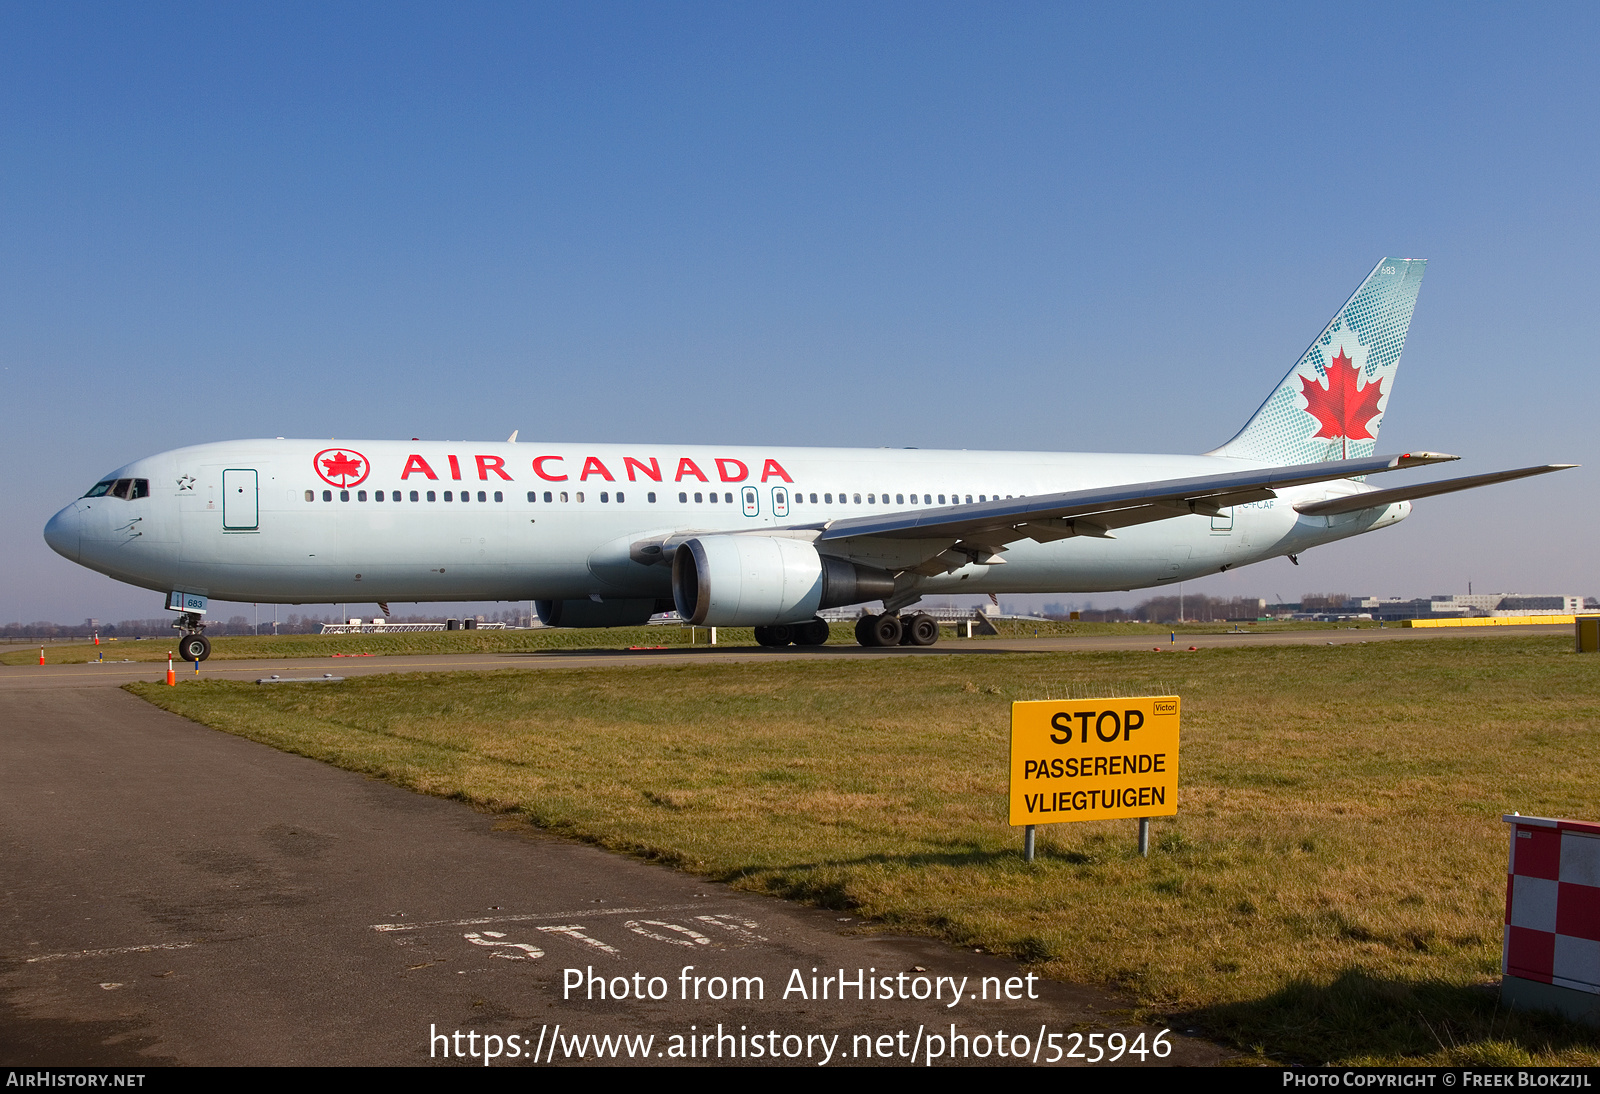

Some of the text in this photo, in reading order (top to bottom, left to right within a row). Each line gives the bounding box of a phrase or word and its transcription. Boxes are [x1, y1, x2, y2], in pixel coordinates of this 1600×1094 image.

[1381, 266, 1396, 275] 683
[400, 454, 795, 483] AIR CANADA
[187, 599, 203, 608] 683
[1155, 703, 1175, 712] Victor
[1050, 709, 1144, 744] STOP
[1024, 753, 1166, 780] PASSERENDE
[1024, 786, 1166, 813] VLIEGTUIGEN
